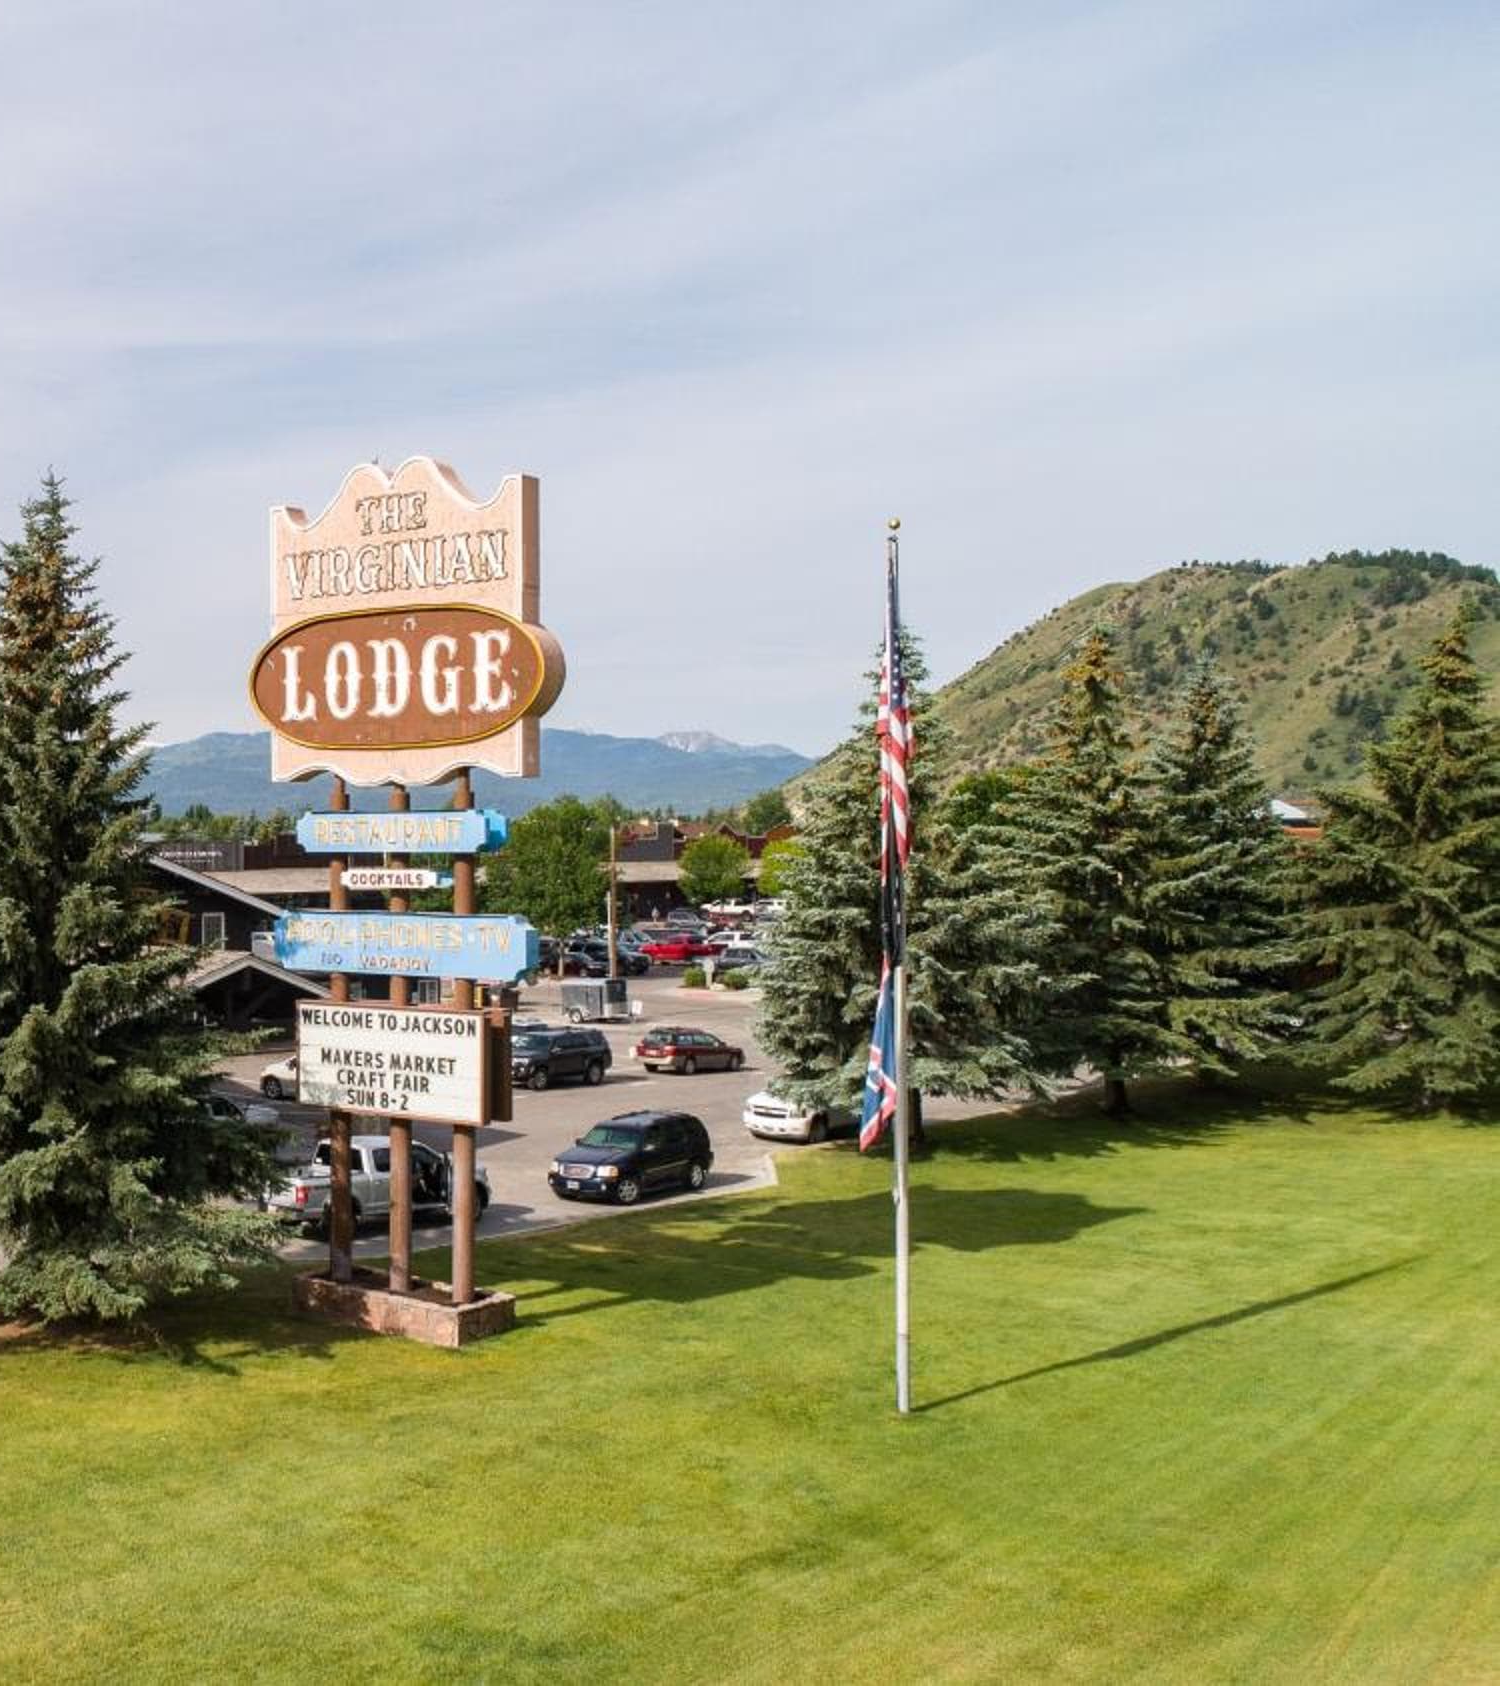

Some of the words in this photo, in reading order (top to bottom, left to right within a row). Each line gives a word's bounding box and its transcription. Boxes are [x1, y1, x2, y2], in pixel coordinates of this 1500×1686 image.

[355, 491, 428, 536] THE
[285, 528, 509, 600] VIRGINIAN
[280, 628, 511, 722] LODGE
[315, 816, 465, 846] RESTAURANT
[349, 872, 424, 886] COCKTAILS
[321, 951, 343, 965] NO
[360, 953, 433, 973] VACANCY
[301, 1008, 373, 1030] WELCOME
[379, 1013, 398, 1031] TO
[401, 1015, 476, 1037] JACKSON
[321, 1047, 384, 1069] MAKERS
[389, 1054, 457, 1075] MARKET
[336, 1069, 386, 1088] CRAFT
[393, 1075, 430, 1093] FAIR
[347, 1089, 375, 1107] SUN
